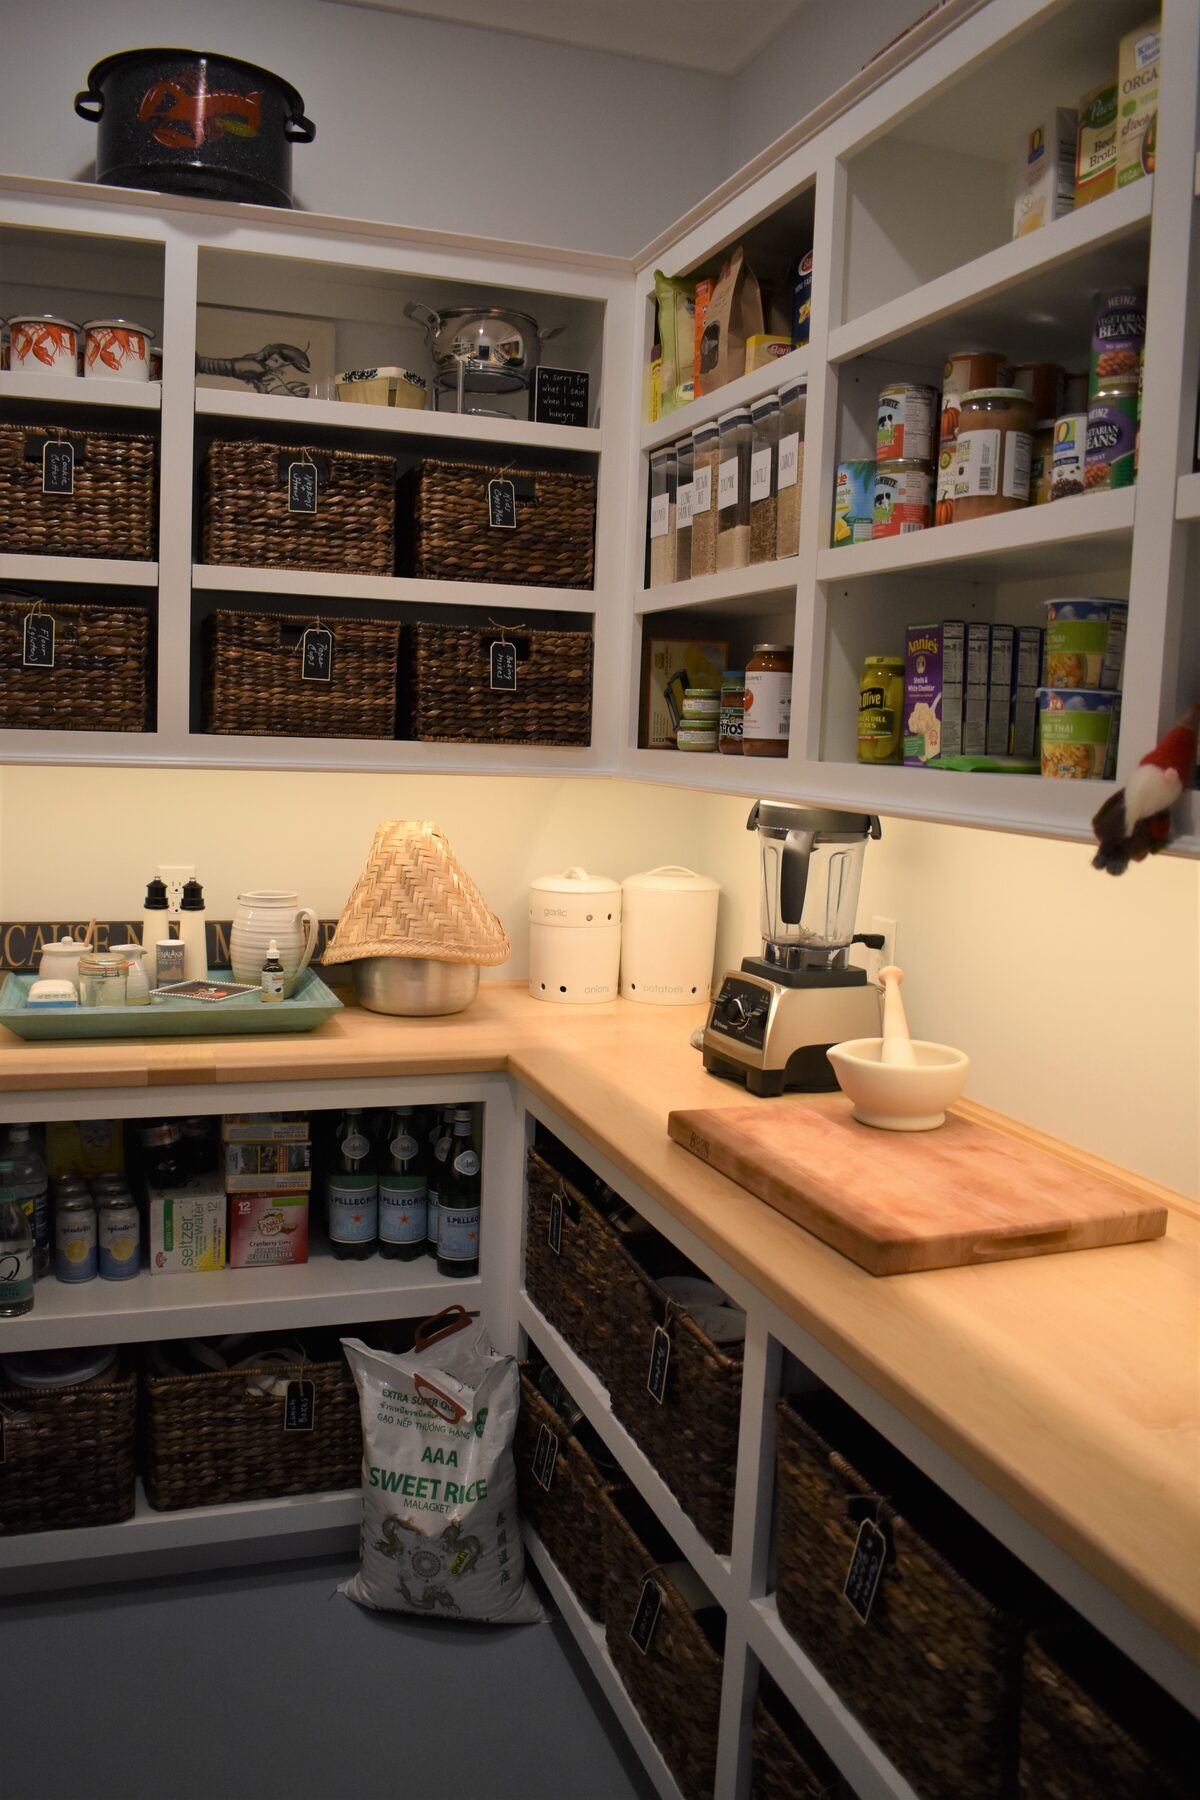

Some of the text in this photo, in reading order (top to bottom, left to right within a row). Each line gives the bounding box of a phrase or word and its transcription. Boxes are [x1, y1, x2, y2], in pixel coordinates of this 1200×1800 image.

[1122, 67, 1158, 94] ORGA
[1094, 131, 1116, 153] Beef
[1089, 145, 1117, 167] Broth
[1108, 295, 1137, 309] HEINZ
[1099, 322, 1146, 340] BEANS
[770, 344, 794, 355] Bari
[553, 374, 572, 385] sorry
[576, 375, 588, 385] for
[541, 384, 560, 394] what
[570, 387, 585, 396] said
[543, 396, 560, 405] when
[1087, 424, 1119, 438] ETARIAN
[1086, 433, 1117, 450] EANS
[61, 454, 70, 486] Cookie
[303, 474, 313, 508] Napkins
[38, 628, 49, 656] Flour
[906, 634, 939, 656] Annie's
[307, 643, 315, 667] Cups
[314, 642, 328, 668] Paper
[504, 655, 513, 681] Baking
[862, 691, 881, 707] Olive
[544, 908, 568, 918] garlic
[585, 985, 610, 994] onions
[643, 985, 684, 995] potatoes
[208, 1202, 218, 1214] 12
[238, 1201, 251, 1210] 12
[331, 1194, 378, 1206] .PELLEGRI
[380, 1194, 427, 1206] .PELLEGRI
[193, 1201, 204, 1235] water
[257, 1217, 285, 1230] CANADA
[266, 1225, 280, 1234] DRY
[179, 1216, 193, 1266] seltzer
[382, 1389, 408, 1403] EXTRA
[411, 1396, 438, 1407] SUER
[421, 1446, 458, 1468] AAA
[369, 1467, 488, 1504] SWEET RICE
